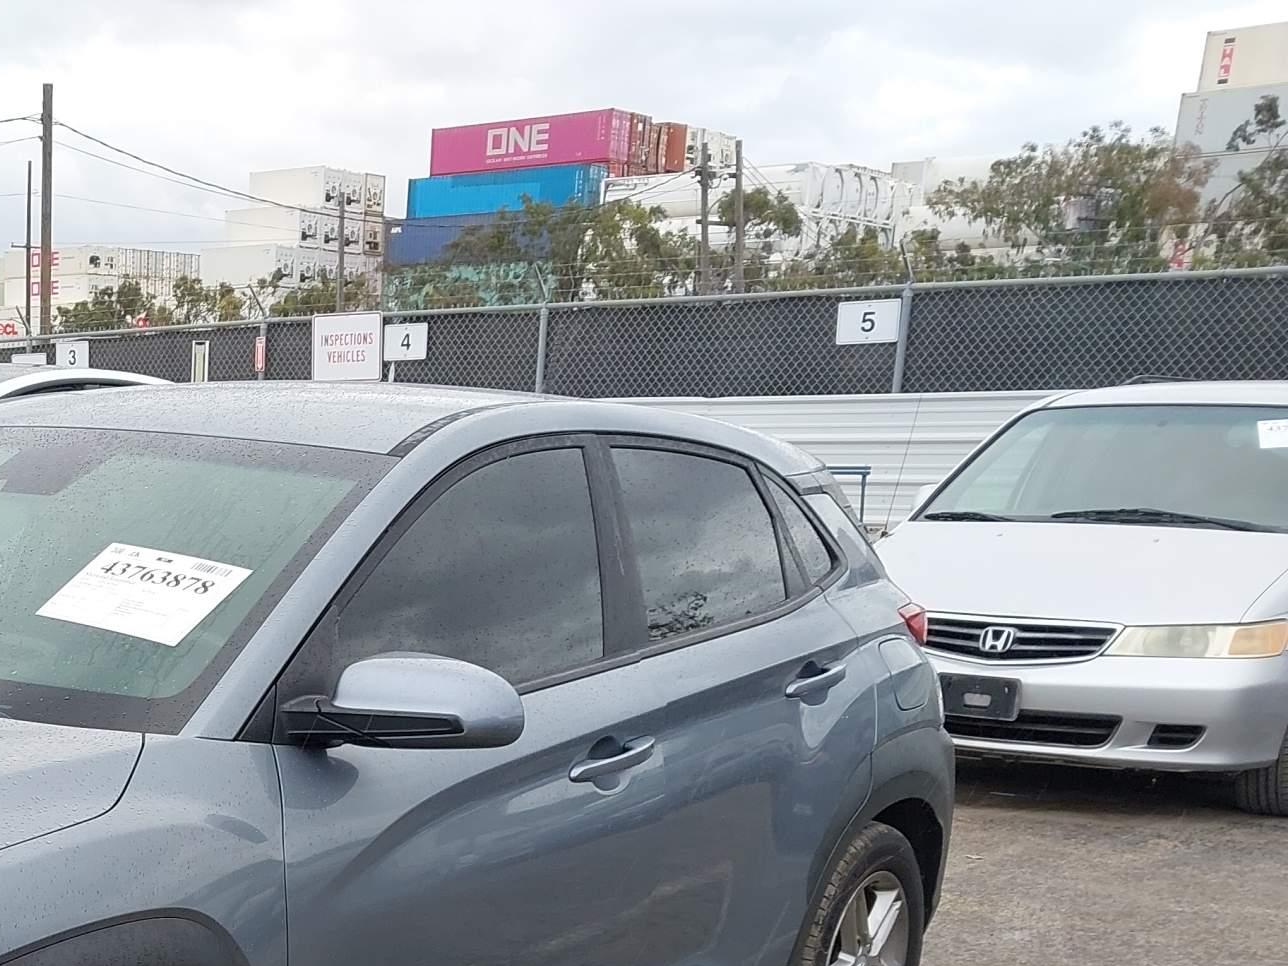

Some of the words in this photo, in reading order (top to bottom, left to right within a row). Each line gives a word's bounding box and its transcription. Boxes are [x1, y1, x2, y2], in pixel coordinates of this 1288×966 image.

[486, 123, 550, 156] ONE
[861, 312, 875, 333] 5
[320, 332, 373, 347] INSPECTIONS
[400, 333, 411, 351] 4
[68, 349, 77, 366] 3
[327, 350, 366, 364] VEHICLES
[100, 561, 215, 594] 43763878
